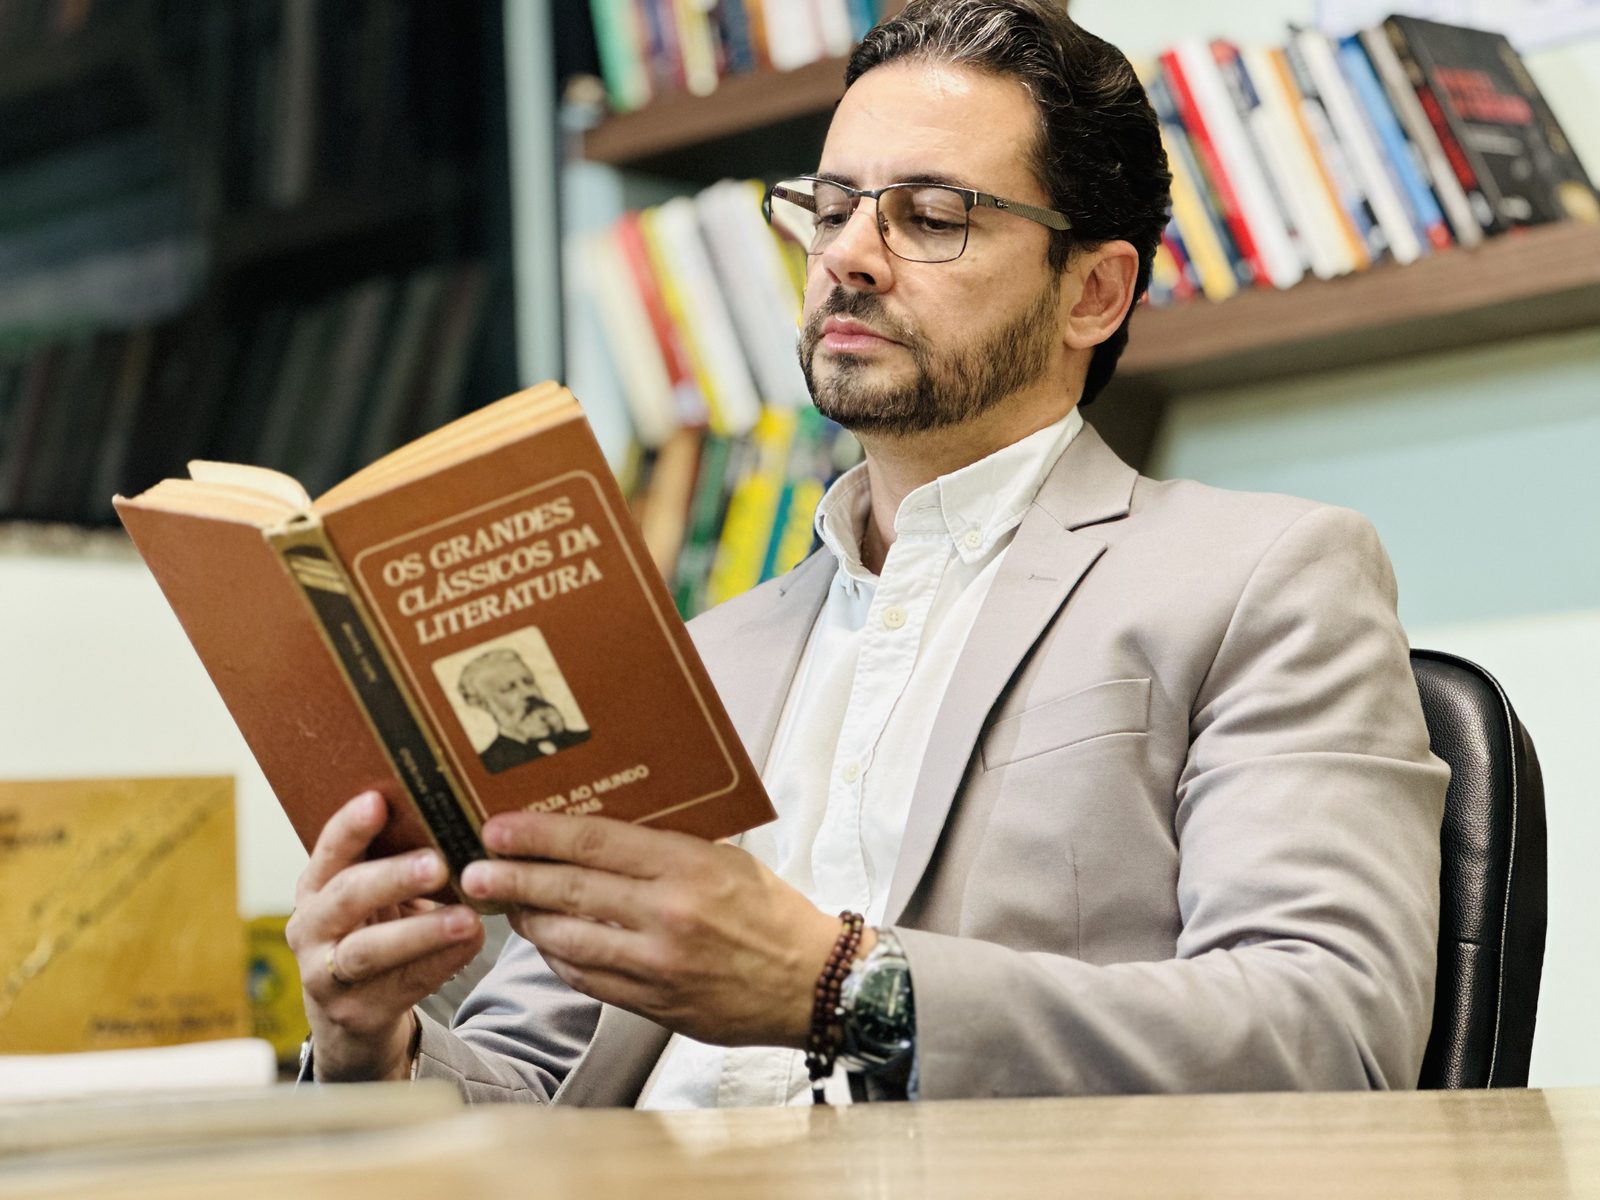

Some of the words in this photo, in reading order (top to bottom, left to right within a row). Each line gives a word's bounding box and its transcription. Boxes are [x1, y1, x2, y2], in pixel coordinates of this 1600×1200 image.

[383, 553, 425, 587] OS
[429, 496, 575, 570] GRANDES
[398, 539, 554, 616] CLÁSSICOS
[558, 524, 601, 558] DA
[415, 558, 603, 645] LITERATURA
[522, 794, 567, 813] OLTA
[570, 785, 592, 802] AO
[593, 764, 649, 793] MUNDO
